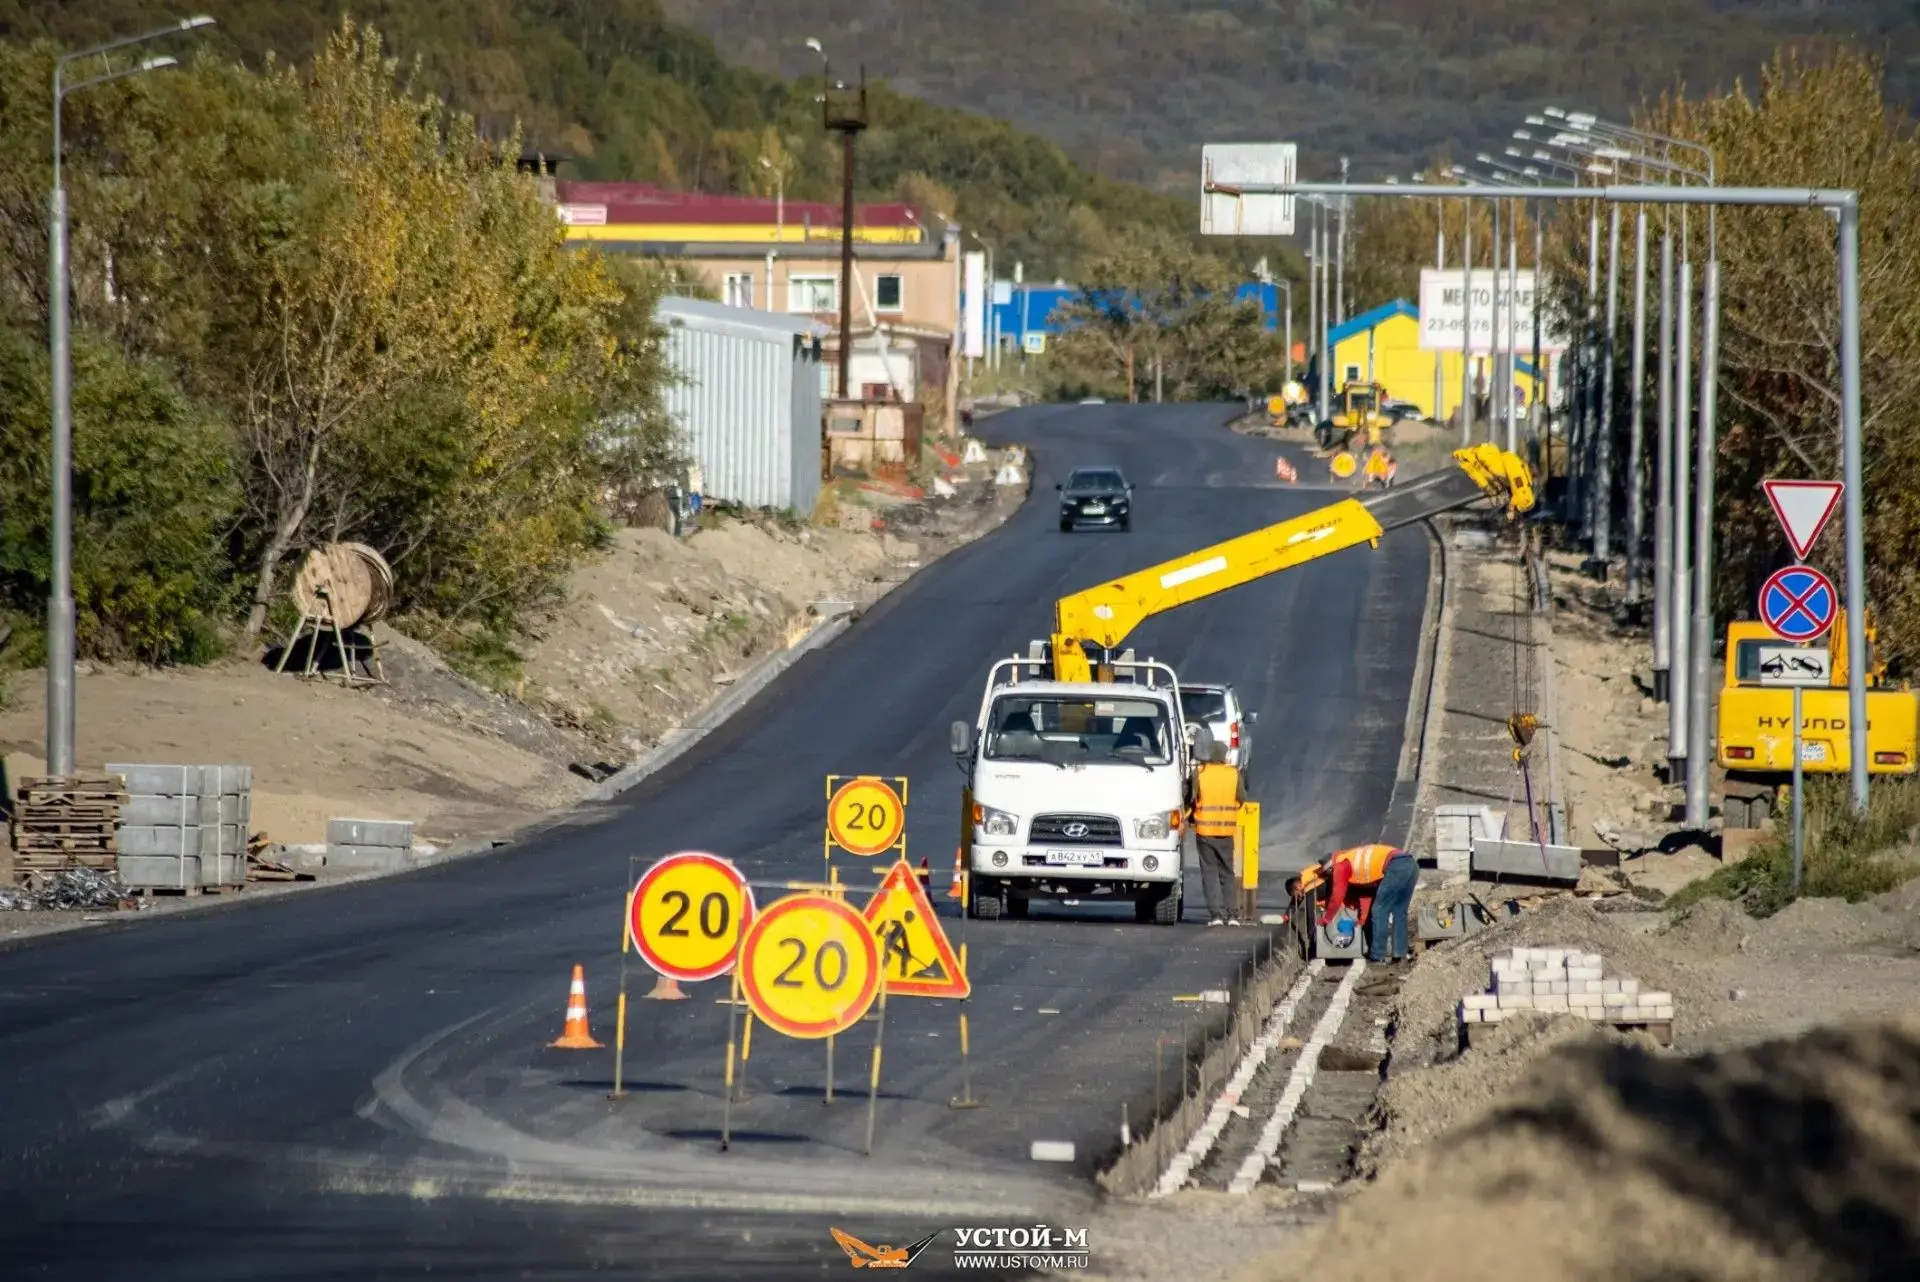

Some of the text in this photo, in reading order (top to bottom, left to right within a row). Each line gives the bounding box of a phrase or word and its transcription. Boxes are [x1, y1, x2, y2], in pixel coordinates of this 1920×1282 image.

[1442, 288, 1490, 306] МЕТО
[1758, 716, 1872, 731] HYUNDI
[846, 803, 886, 830] 20
[658, 890, 730, 940] 20
[772, 937, 849, 992] 20
